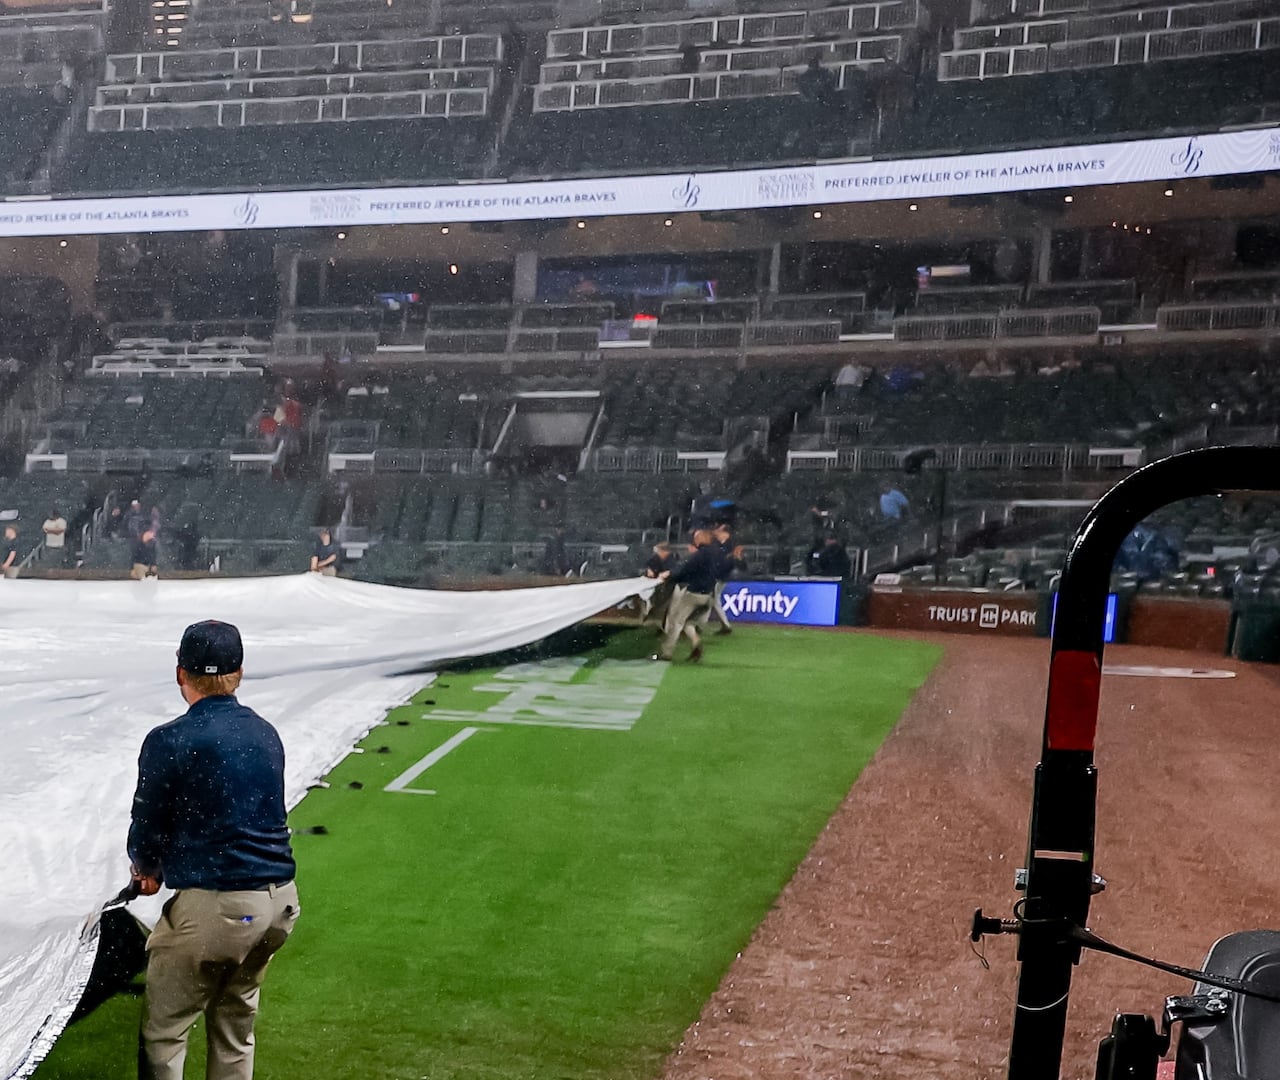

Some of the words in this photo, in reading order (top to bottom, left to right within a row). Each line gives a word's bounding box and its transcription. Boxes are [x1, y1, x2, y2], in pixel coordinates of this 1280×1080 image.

[825, 175, 894, 189] PREFERRED
[897, 171, 951, 184] JEWELER
[955, 171, 971, 181] OF
[975, 168, 997, 179] THE
[1000, 162, 1054, 177] ATLANTA
[1057, 159, 1105, 173] BRAVES
[370, 200, 431, 211] PREFERRED
[434, 198, 481, 209] JEWELER
[484, 197, 497, 207] OF
[502, 196, 522, 206] THE
[524, 194, 571, 205] ATLANTA
[574, 191, 616, 202] BRAVES
[722, 587, 799, 618] xfinity
[928, 605, 978, 622] TRUIST
[1001, 609, 1037, 625] PARK
